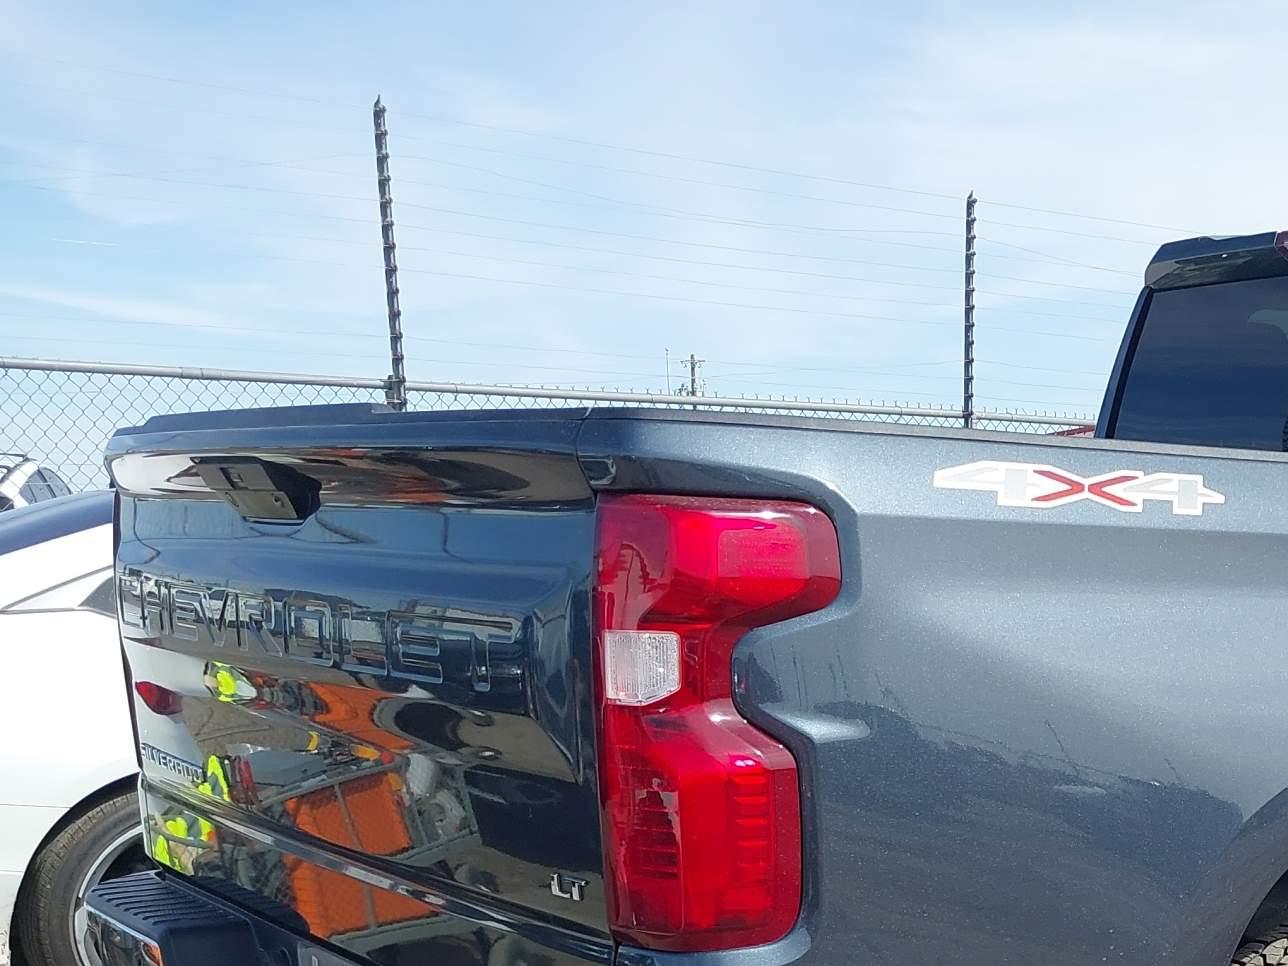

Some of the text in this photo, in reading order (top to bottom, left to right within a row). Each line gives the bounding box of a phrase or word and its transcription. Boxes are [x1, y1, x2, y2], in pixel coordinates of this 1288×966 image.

[117, 568, 523, 693] CHEVROLET
[140, 743, 203, 783] SILVERADO
[550, 873, 590, 901] LT
